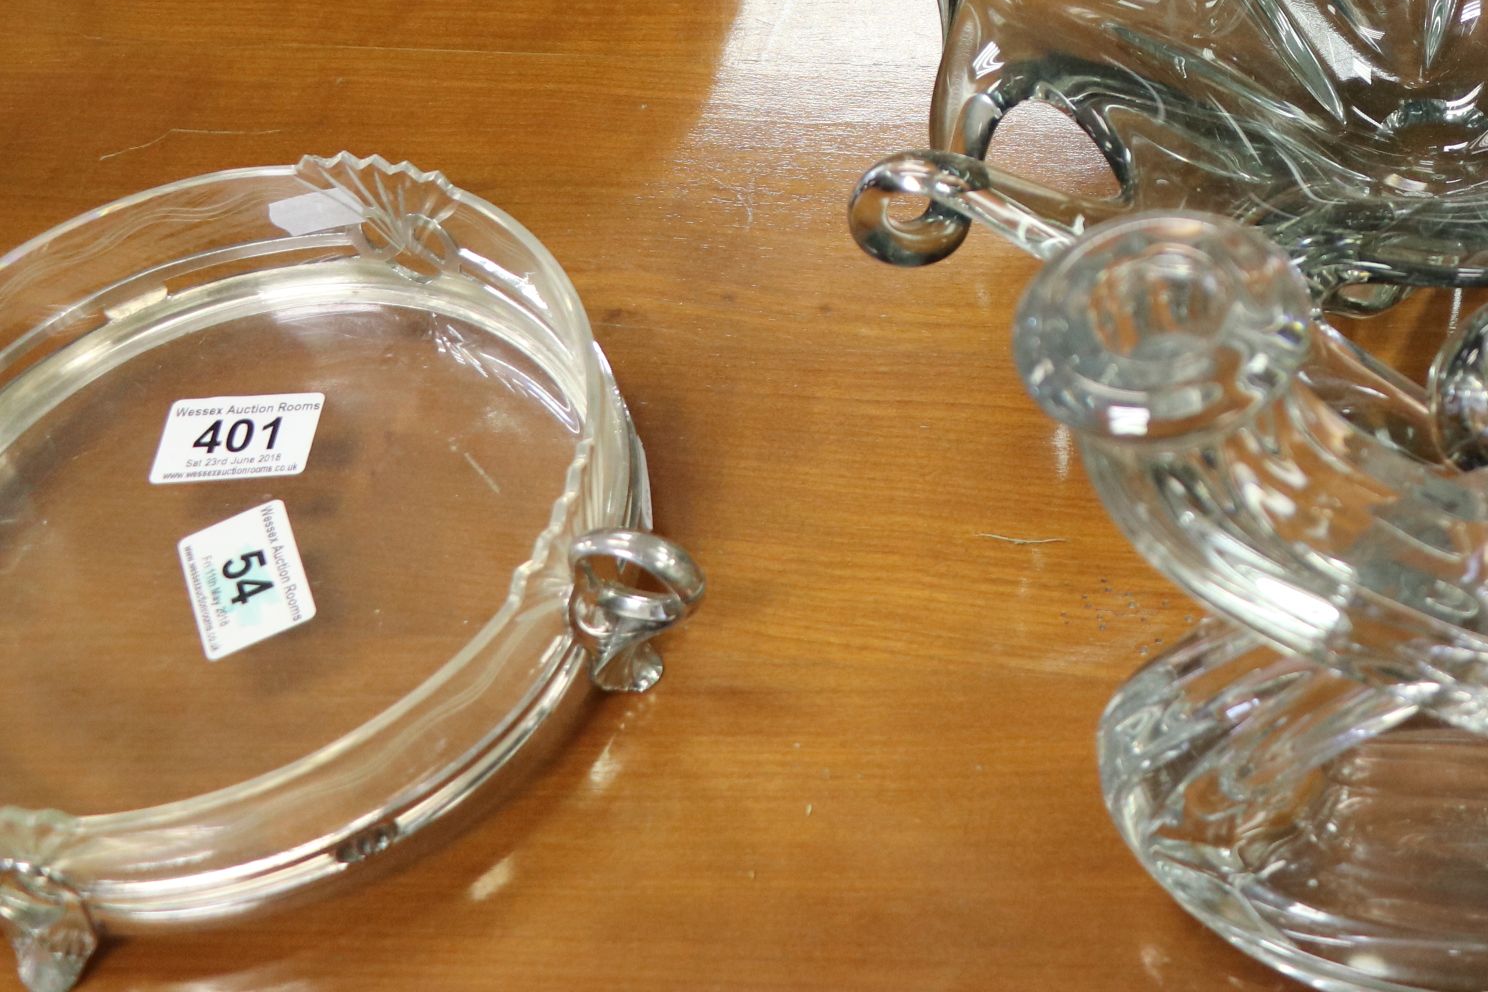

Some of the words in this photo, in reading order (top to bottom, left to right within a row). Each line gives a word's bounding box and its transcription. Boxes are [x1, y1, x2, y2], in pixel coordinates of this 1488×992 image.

[176, 407, 223, 418] Wessex
[227, 404, 274, 416] Auction
[277, 401, 320, 412] Rooms
[192, 416, 284, 454] 401
[186, 458, 202, 468] Sat
[205, 457, 228, 467] 23rd
[230, 455, 255, 465] June
[258, 453, 282, 463] 2018
[222, 549, 274, 605] 54
[260, 505, 280, 544] Wessex
[272, 544, 291, 584] Auction
[285, 583, 302, 622] Rooms
